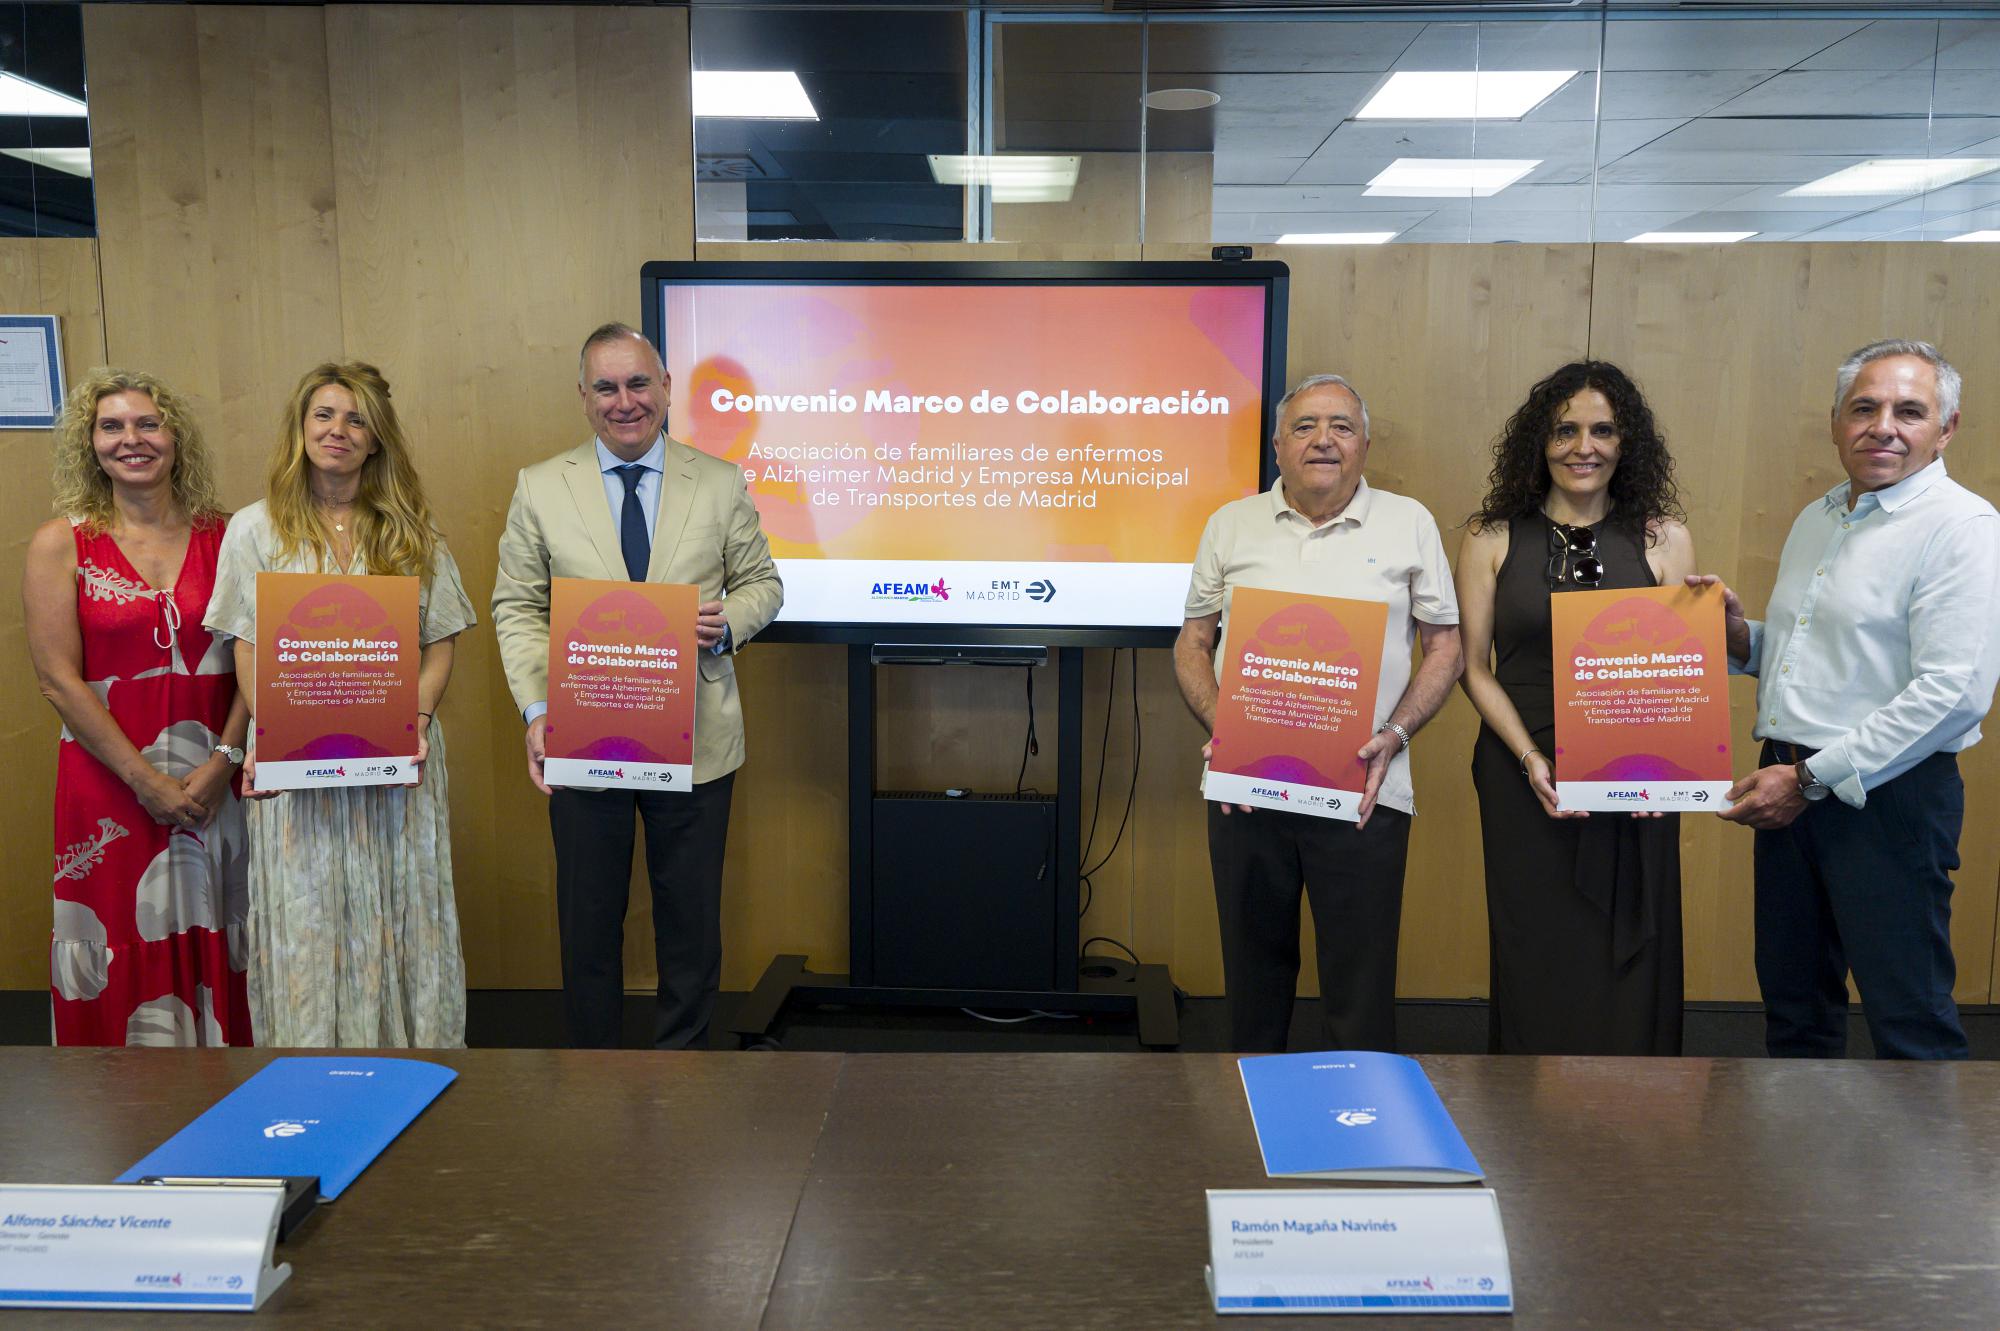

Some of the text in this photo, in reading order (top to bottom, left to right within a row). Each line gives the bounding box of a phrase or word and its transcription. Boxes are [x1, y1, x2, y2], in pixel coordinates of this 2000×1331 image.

[711, 389, 1229, 414] Convenio Marco de Colaboración
[748, 442, 1163, 462] Asociación de familiares de enfermos
[763, 465, 870, 483] Alzheimer
[877, 466, 954, 483] Madrid
[961, 470, 972, 487] y
[979, 467, 1073, 488] Empresa
[1081, 468, 1189, 489] Municipal
[813, 488, 1096, 510] de Transportes de Madrid
[872, 583, 928, 595] AFEAM
[992, 581, 1020, 589] EMT
[967, 592, 1020, 600] MADRID
[279, 638, 398, 649] Convenio Marco
[568, 641, 677, 656] Convenio Marco
[278, 651, 399, 662] de Colaboración
[568, 654, 677, 669] de Colaboración
[1575, 652, 1703, 667] Convenio Marco
[1244, 653, 1359, 676] Convenio Marco
[568, 673, 610, 681] Asociación
[624, 676, 661, 685] familiares
[1242, 666, 1358, 690] de Colaboración
[1575, 665, 1704, 680] de Colaboración
[334, 689, 374, 697] Municipal
[561, 682, 598, 690] enfermos
[612, 684, 650, 693] Alzheimer
[652, 686, 680, 694] Madrid
[1576, 686, 1701, 697] Asociación de familiares de
[581, 691, 614, 700] Empresa
[616, 692, 653, 702] Municipal
[1240, 686, 1284, 698] Asociación
[1299, 693, 1339, 705] familiares
[1569, 699, 1612, 707] enfermos
[1628, 697, 1673, 705] Alzheimer
[576, 699, 621, 708] Transportes
[1232, 694, 1358, 717] enfermos de Alzheimer Madrid
[1251, 705, 1287, 717] Empresa
[1288, 710, 1328, 722] Municipal
[1331, 715, 1341, 723] de
[1592, 707, 1630, 716] Empresa
[1633, 706, 1678, 715] Municipal
[1245, 713, 1293, 726] Transportes
[1309, 722, 1339, 732] Madrid
[1587, 717, 1640, 725] Transportes
[1643, 715, 1655, 723] de
[1252, 787, 1280, 797] AFEAM
[3, 1214, 172, 1228] Alfonso Sánchez Vicente
[1232, 1220, 1397, 1235] Ramón Magaña Navinés
